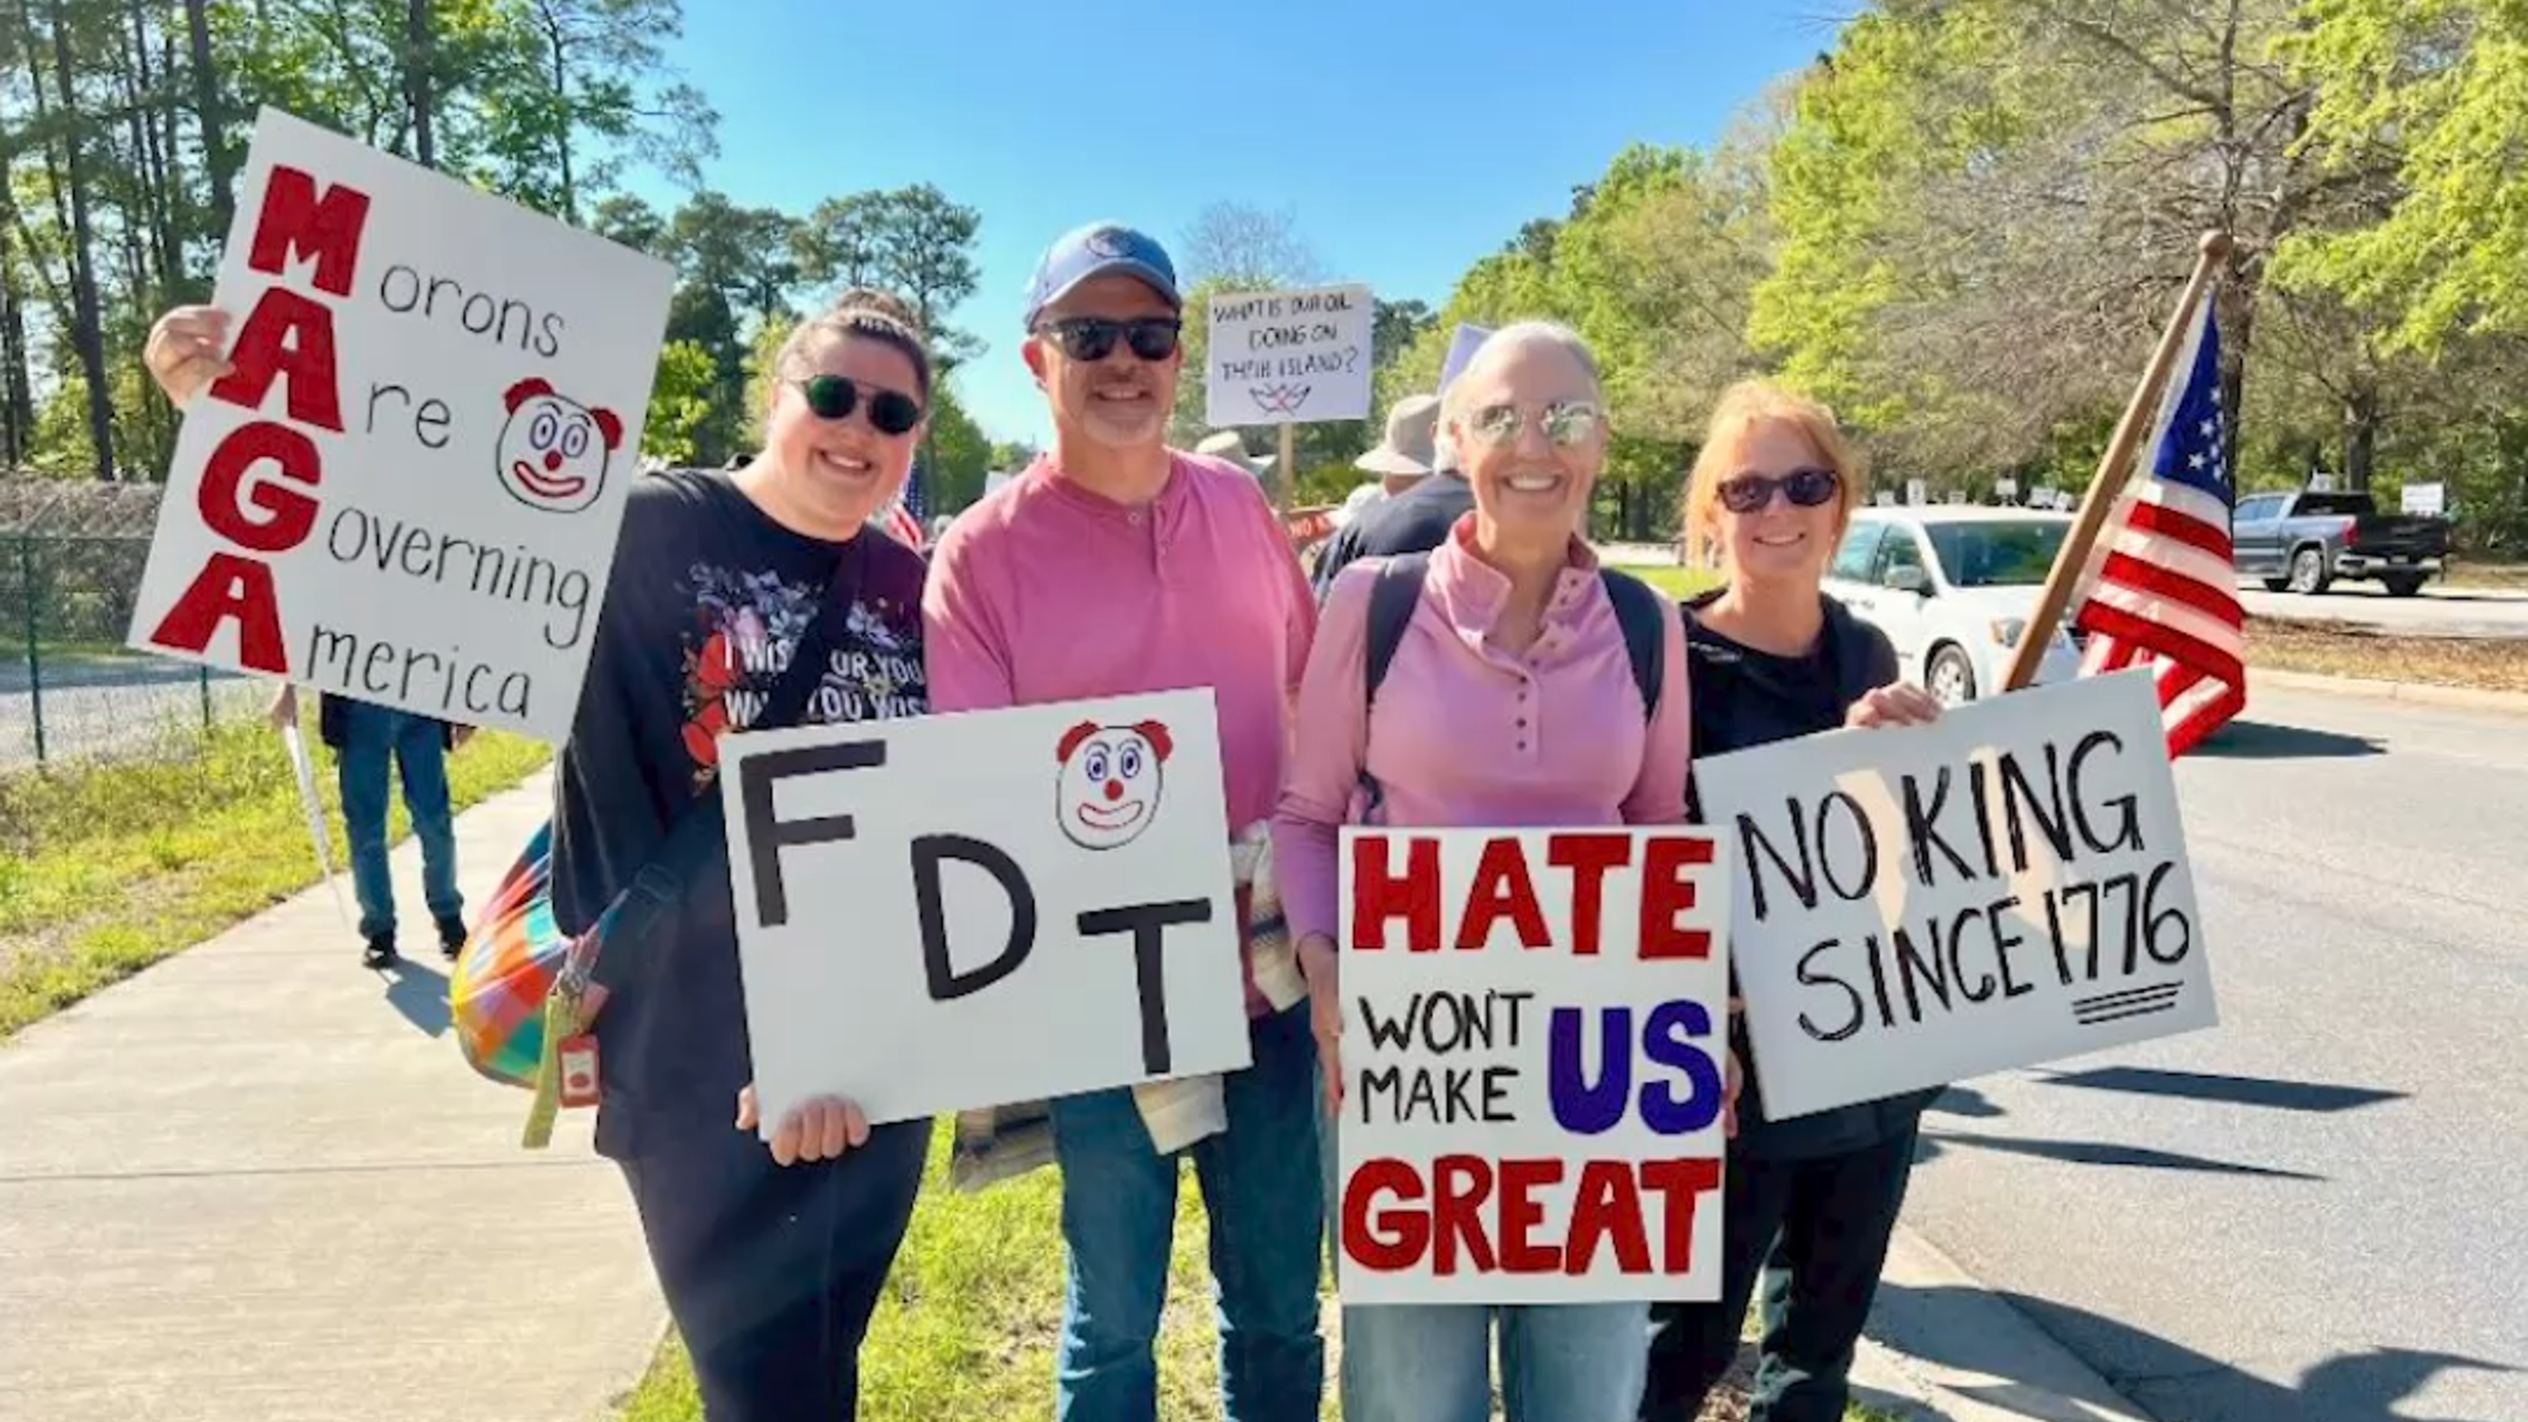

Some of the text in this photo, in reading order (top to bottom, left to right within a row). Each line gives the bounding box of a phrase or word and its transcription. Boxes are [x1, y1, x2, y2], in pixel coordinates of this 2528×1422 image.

[1310, 323, 1337, 343] ON
[740, 637, 791, 672] WIS
[1737, 730, 2144, 921] NO KING
[1352, 833, 1714, 959] HATE
[1797, 861, 2190, 1041] SINCE 1776
[1359, 1065, 1520, 1124] MAKE
[1547, 1000, 1721, 1135] US
[1342, 1154, 1720, 1276] GREAT
